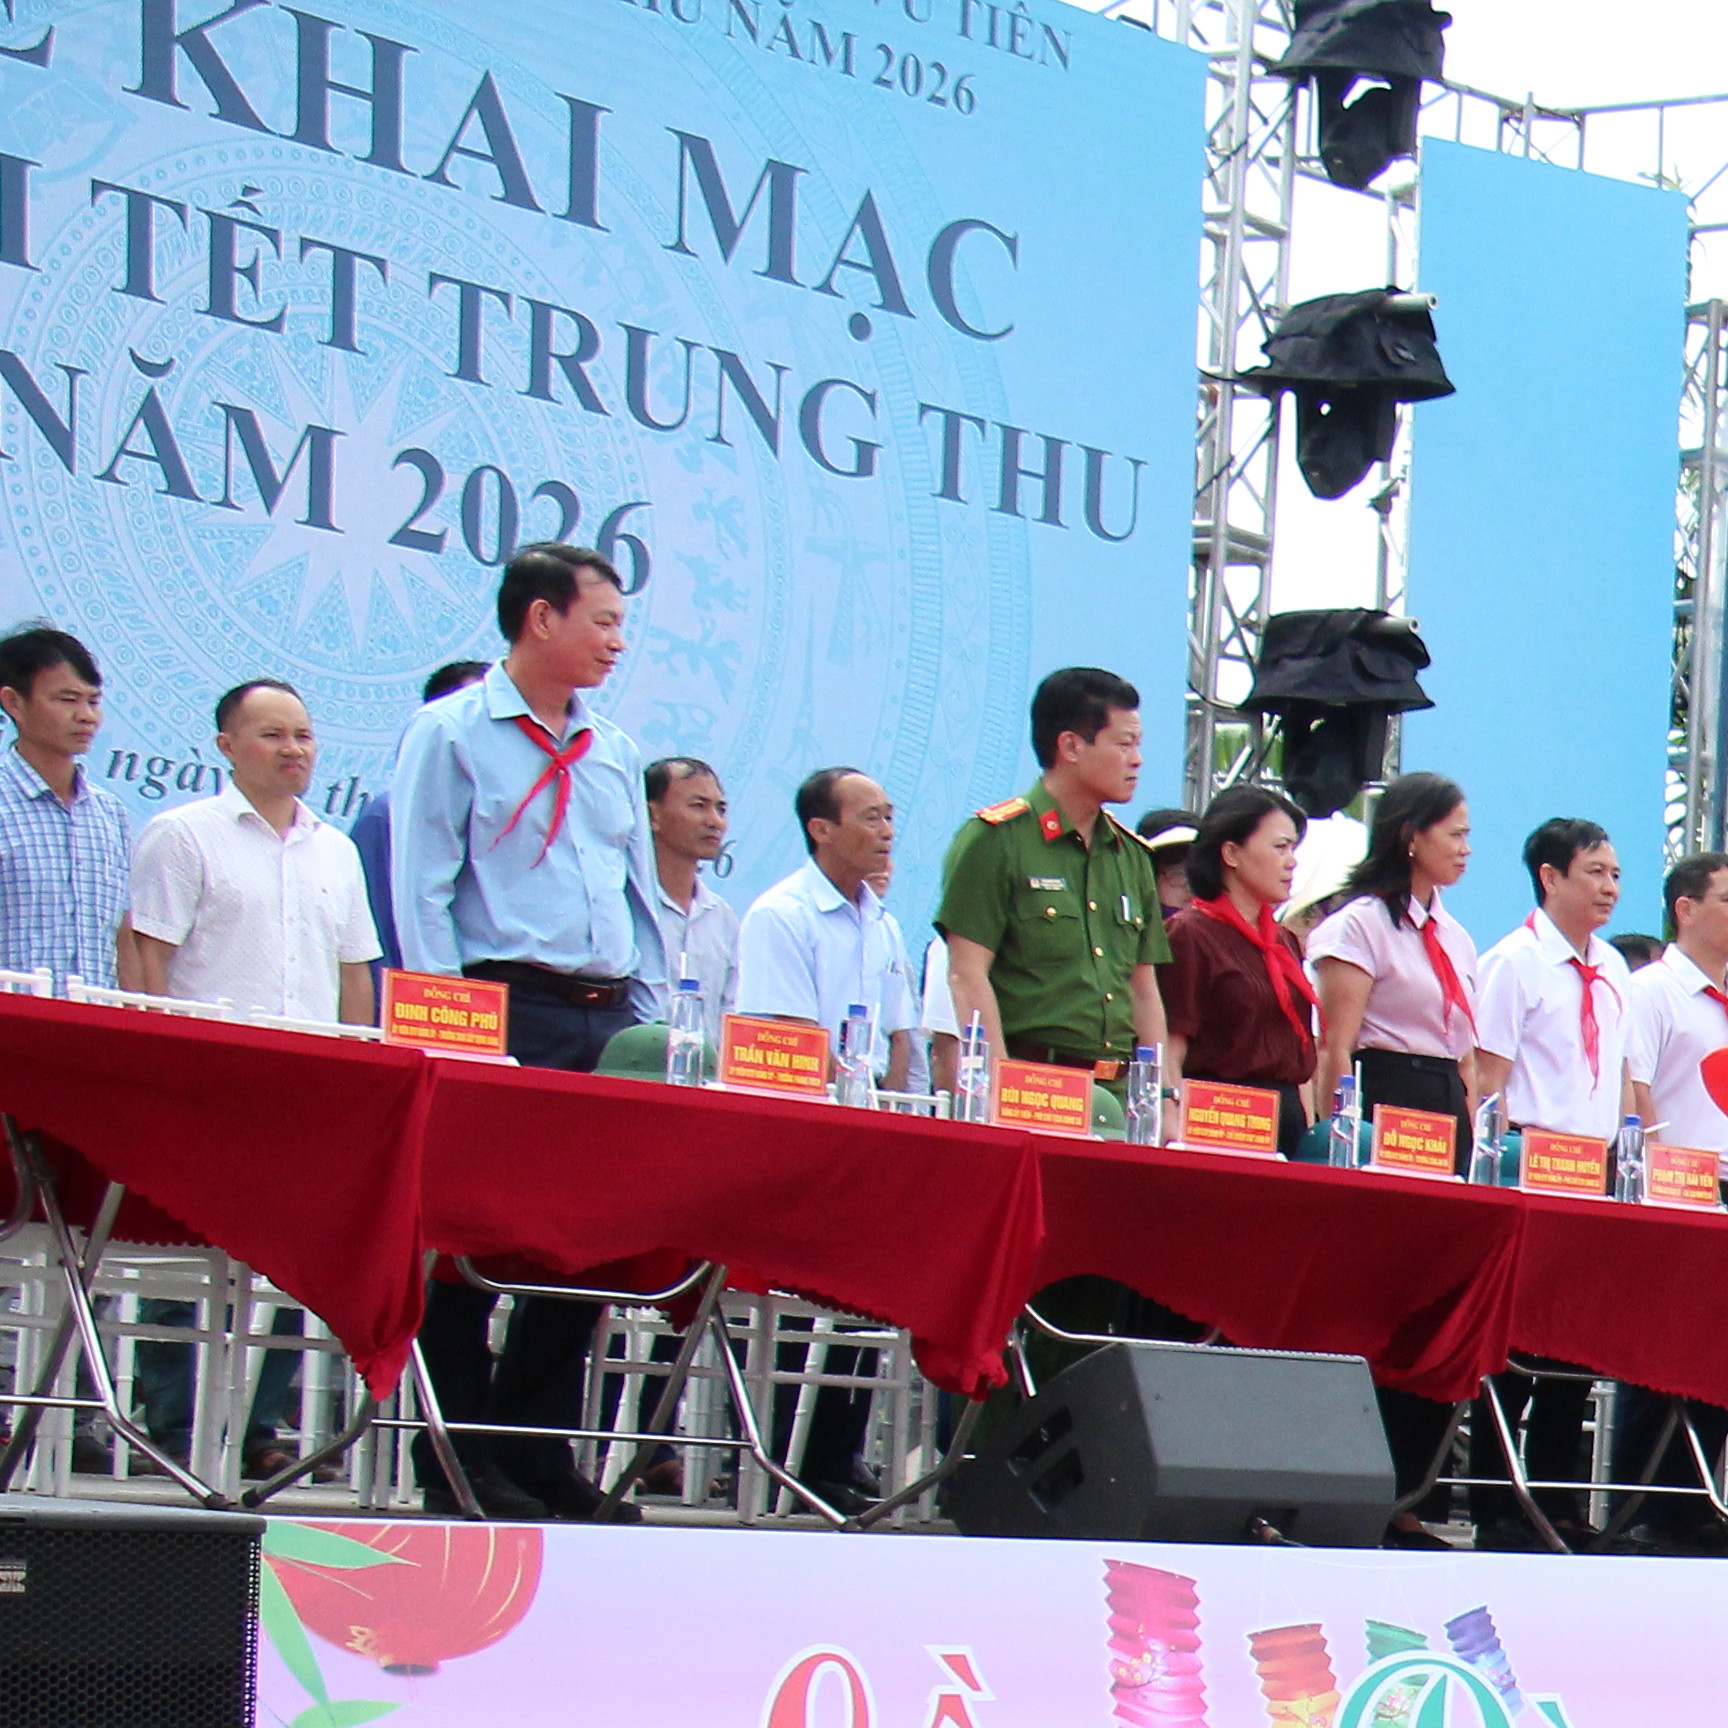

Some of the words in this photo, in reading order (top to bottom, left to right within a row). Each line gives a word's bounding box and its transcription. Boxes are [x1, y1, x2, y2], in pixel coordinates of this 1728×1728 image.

[725, 0, 859, 78] NĂM
[873, 43, 978, 116] 2026
[121, 0, 614, 233] KHAI
[663, 126, 1019, 341] MẠC
[91, 178, 390, 356] TẾT
[428, 271, 883, 478] TRUNG
[917, 401, 1149, 542] THU
[388, 447, 655, 597] 2026
[431, 1004, 469, 1026] CÔNG
[765, 1048, 790, 1068] VĂN
[1050, 1094, 1085, 1112] QUANG
